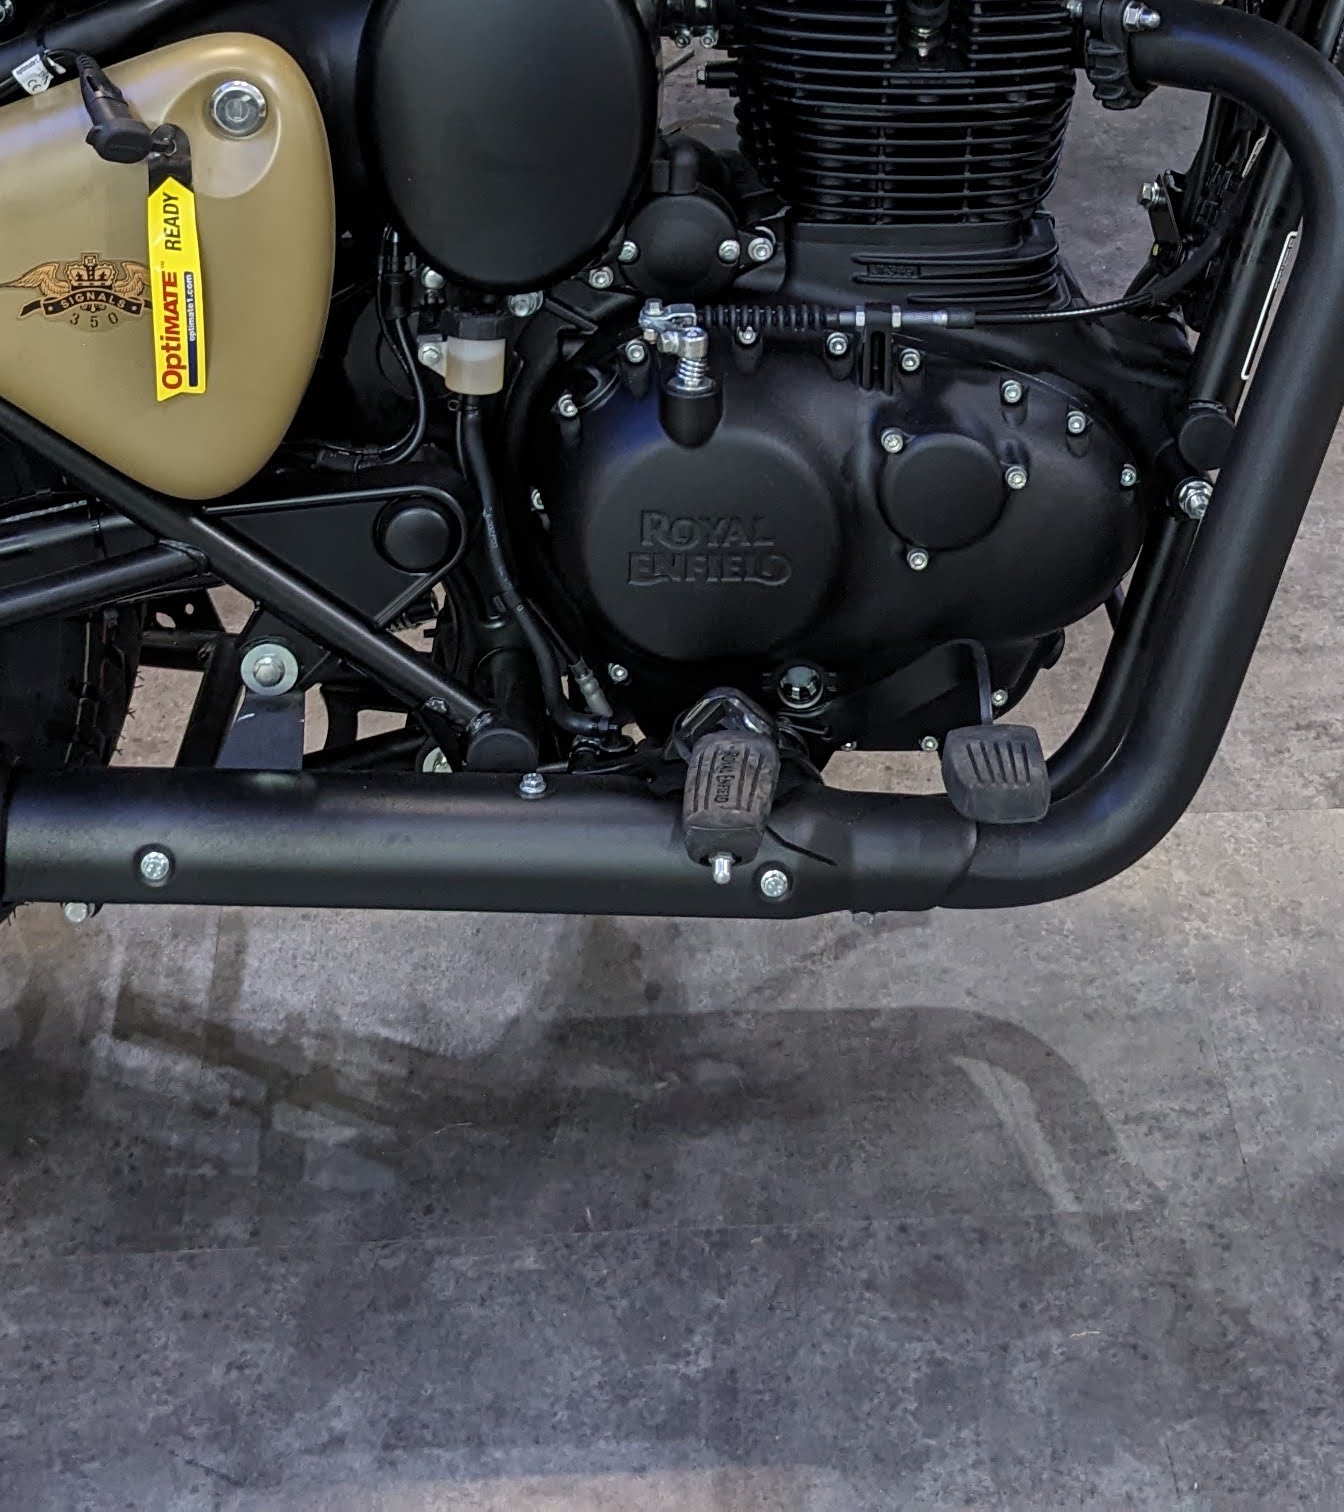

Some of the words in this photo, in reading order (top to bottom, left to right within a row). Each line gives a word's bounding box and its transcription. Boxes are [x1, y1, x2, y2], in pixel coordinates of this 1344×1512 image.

[162, 192, 182, 252] READY
[60, 291, 127, 309] SIGNALS
[640, 509, 774, 550] ROYAL
[627, 552, 792, 586] ENFIELD
